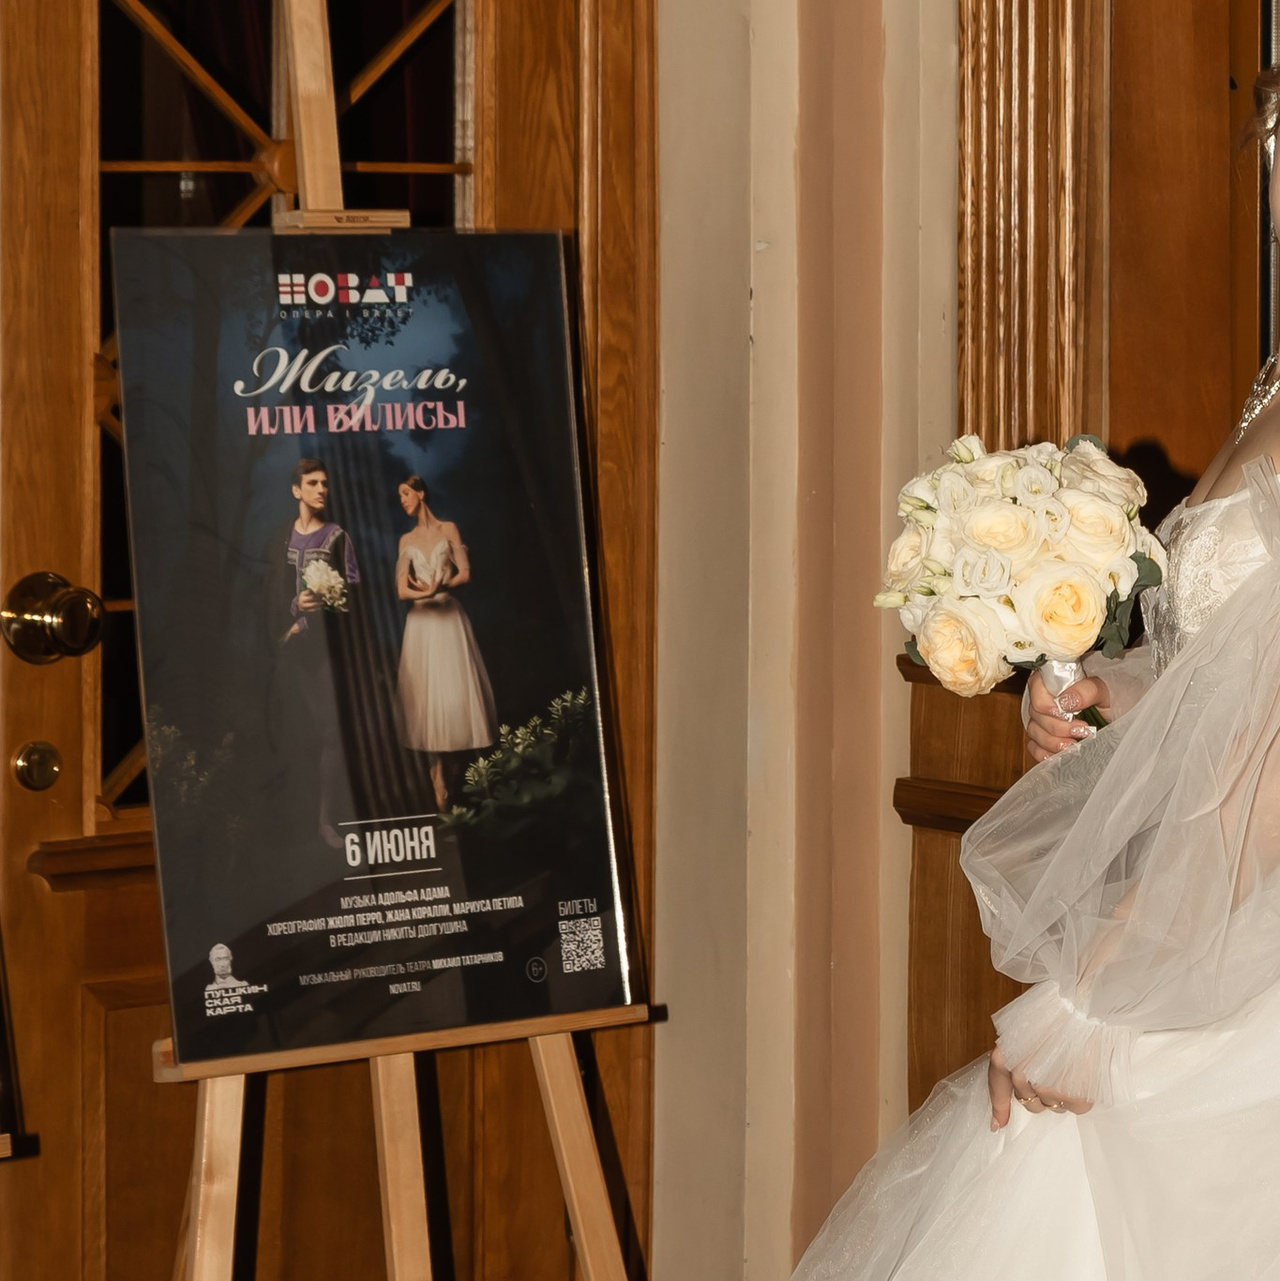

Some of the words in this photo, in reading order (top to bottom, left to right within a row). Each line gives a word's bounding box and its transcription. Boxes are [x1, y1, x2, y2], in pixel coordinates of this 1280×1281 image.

[278, 273, 413, 305] НОВАТ
[279, 310, 334, 319] ОПЕРА
[362, 309, 414, 317] БАЛЕТ
[233, 344, 467, 426] Жизель,
[246, 406, 316, 436] ИЛИ
[326, 401, 467, 433] ВИЛИСЫ
[345, 833, 362, 867] 6
[365, 826, 436, 865] ИЮНЯ
[340, 894, 377, 910] МУЗЫКА
[378, 889, 419, 906] АДОЛЬФА
[420, 886, 450, 901] АДАМА
[558, 898, 597, 916] БИЛЕТЫ
[267, 918, 326, 936] ХОРЕОГРАФИЯ
[327, 915, 355, 929] ЖЮЛЯ
[385, 908, 411, 923] ЖАНА
[453, 899, 491, 915] МАРИУСА
[492, 896, 524, 910] ПЕТИПА
[329, 935, 336, 948] В
[337, 930, 382, 947] РЕДАКЦИИ
[382, 926, 417, 941] НИКИТЫ
[417, 920, 468, 938] ДОЛГУШИНА
[299, 968, 352, 986] МУЗЫКАЛЬНЫЙ
[406, 960, 432, 973] ТЕАТРА
[432, 956, 461, 970] МИХАИЛ
[461, 951, 504, 966] ТАТАРНИКОВ
[204, 984, 268, 999] ПУШКИН
[205, 996, 242, 1008] СКАЯ
[206, 1004, 254, 1017] КАРТА
